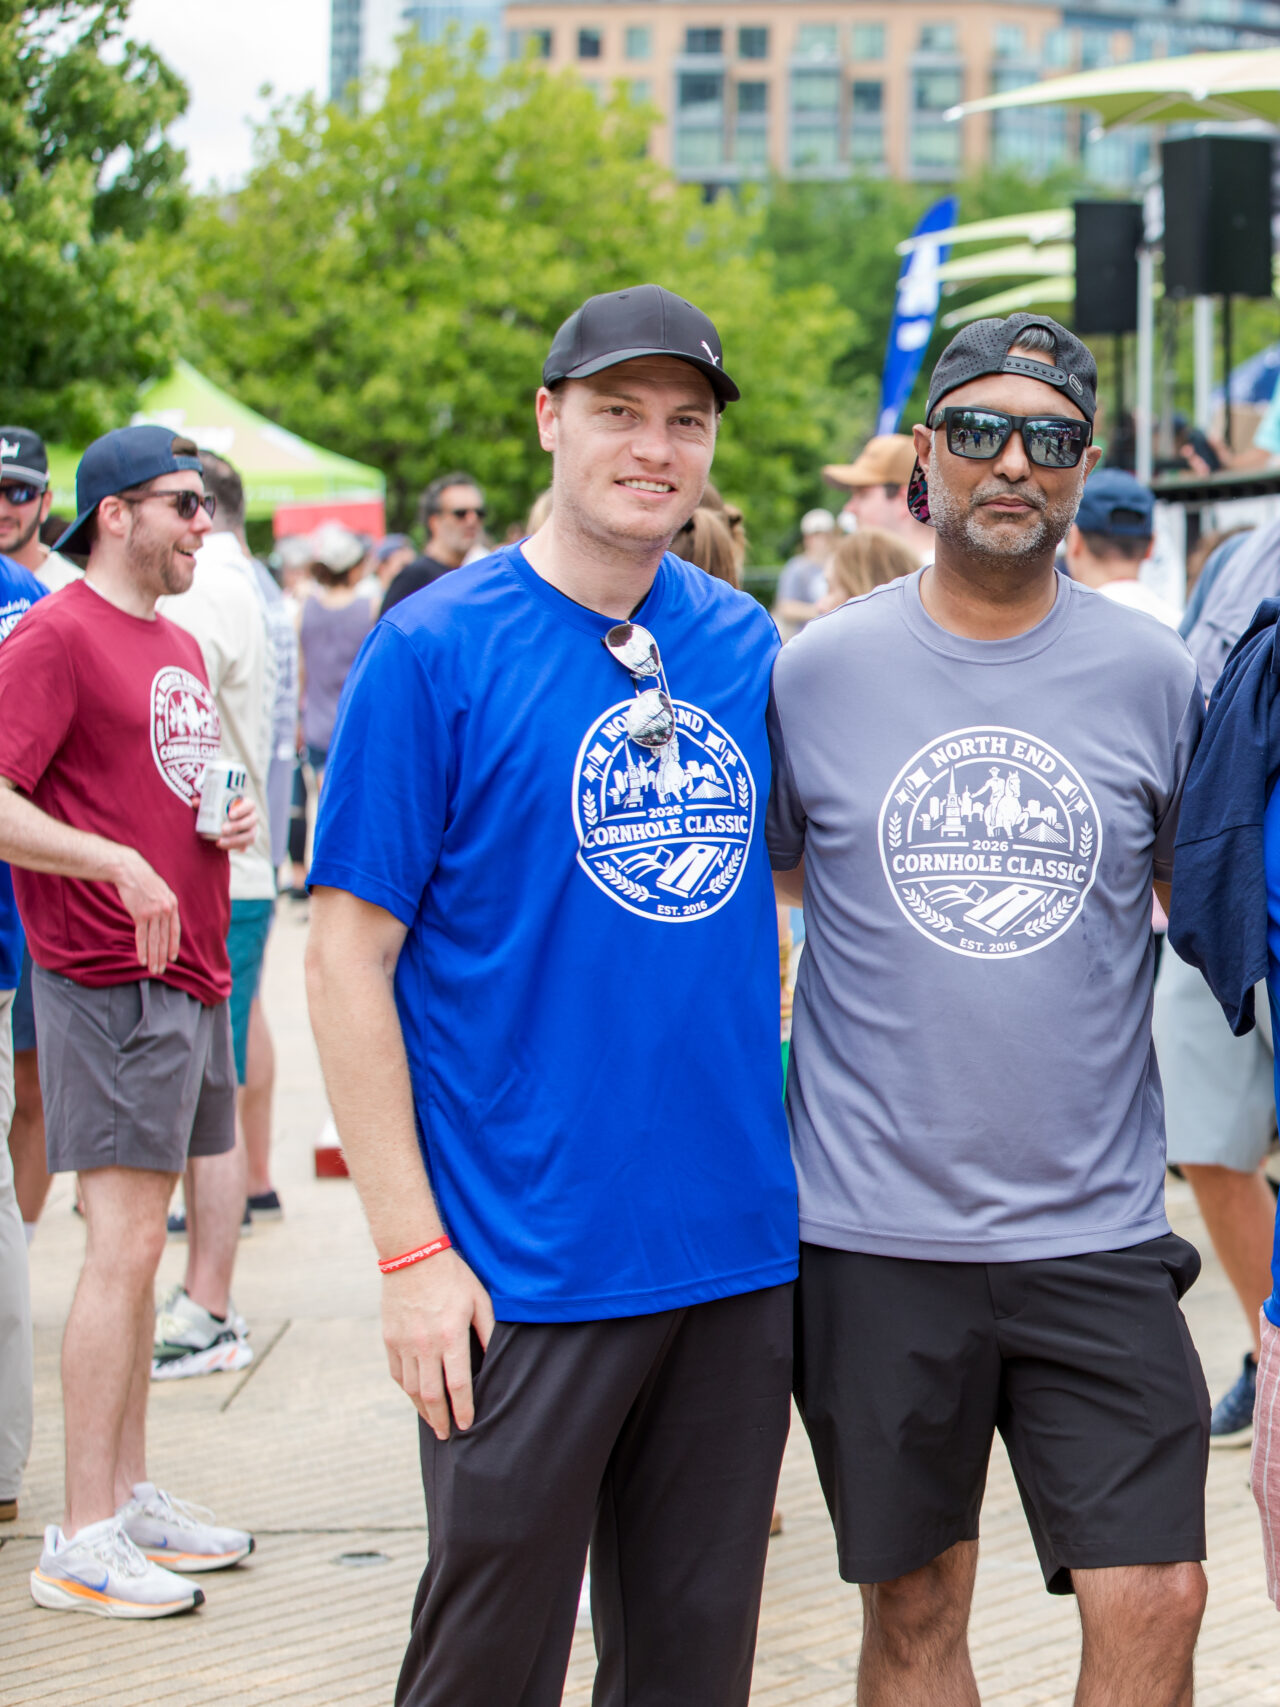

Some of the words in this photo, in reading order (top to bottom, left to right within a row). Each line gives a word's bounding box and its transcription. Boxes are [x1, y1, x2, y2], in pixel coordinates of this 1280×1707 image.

[929, 736, 1007, 768] NORTH
[1011, 739, 1057, 773] END
[648, 804, 683, 819] 2026
[583, 819, 683, 848] CORNHOLE
[685, 815, 749, 834] CLASSIC
[972, 840, 1009, 852] 2026
[892, 853, 1003, 874] CORNHOLE
[1006, 856, 1088, 883] CLASSIC
[657, 903, 681, 916] EST.
[683, 900, 708, 915] 2016
[959, 937, 986, 953] EST.
[989, 940, 1018, 953] 2016
